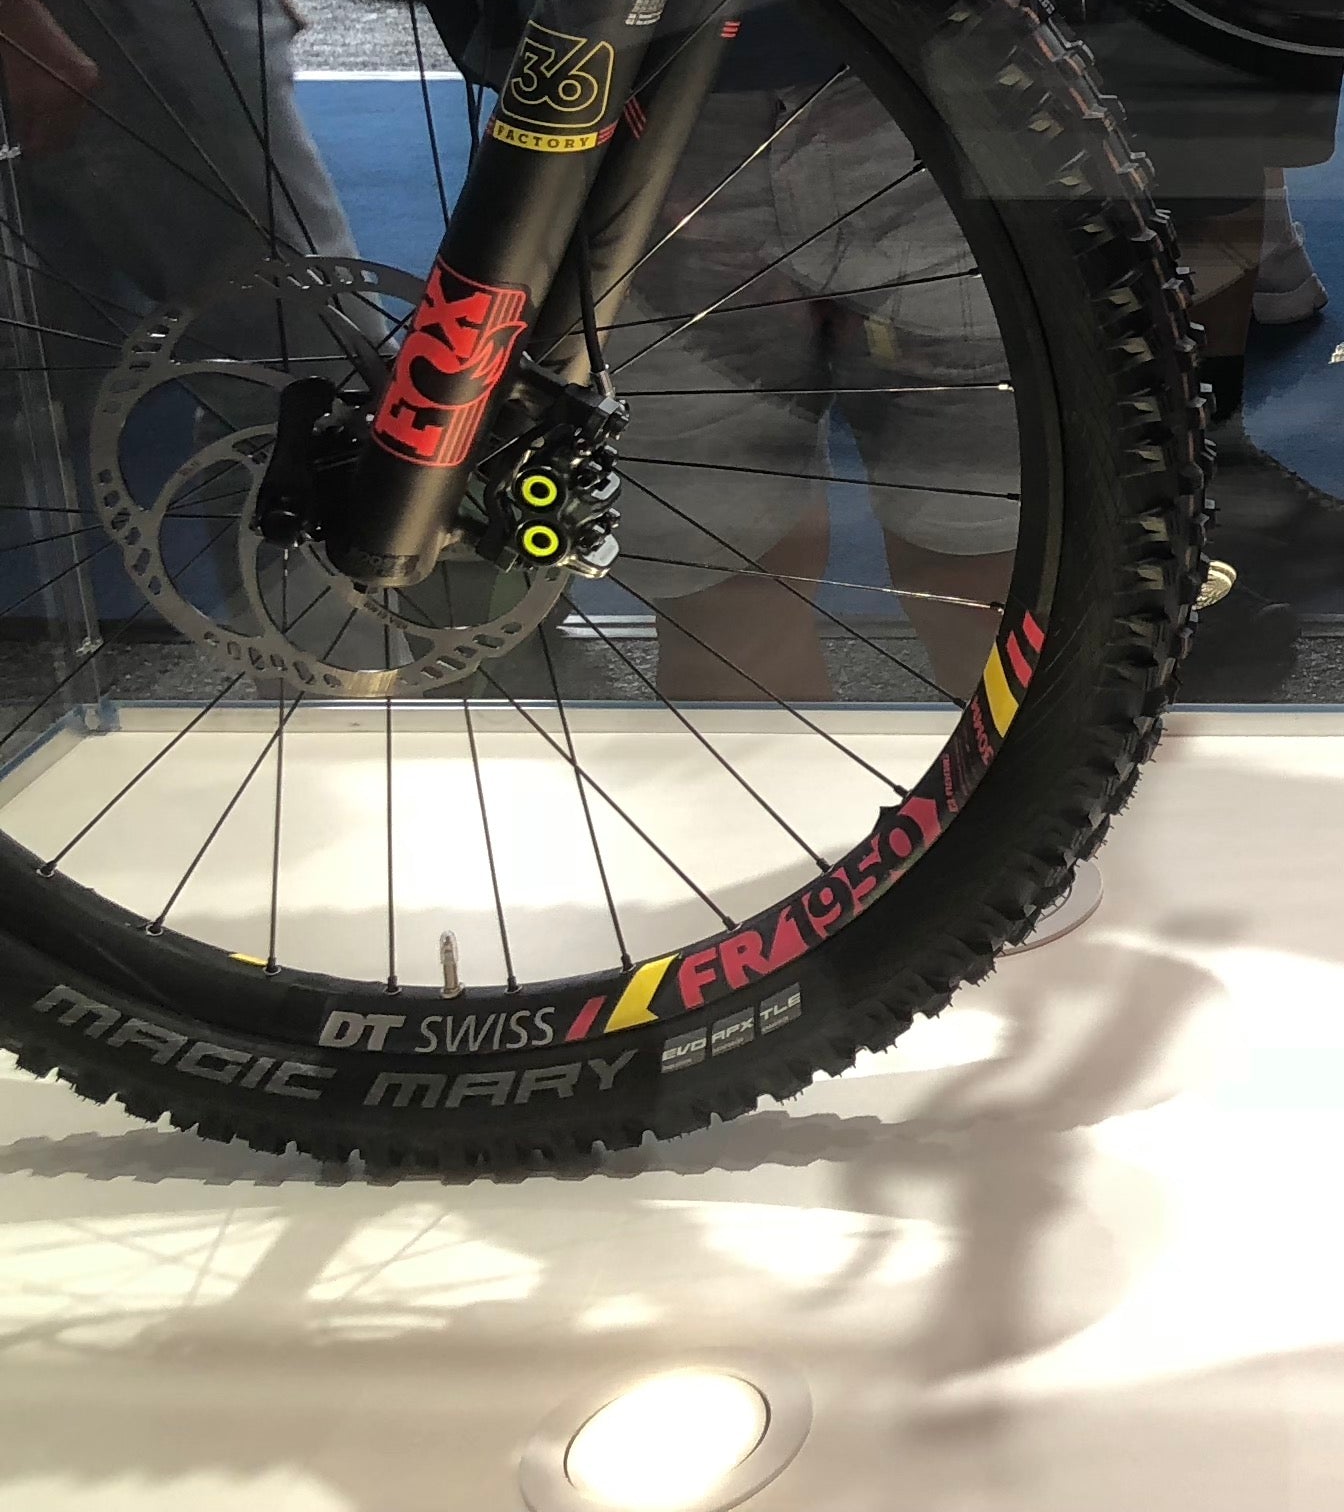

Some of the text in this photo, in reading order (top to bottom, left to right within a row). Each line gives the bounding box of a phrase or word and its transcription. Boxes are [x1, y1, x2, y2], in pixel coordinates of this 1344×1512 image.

[494, 121, 595, 150] FACTORY
[375, 260, 512, 462] FOX
[34, 984, 640, 1110] MAGIC MARY
[318, 1006, 556, 1054] DT SWISS
